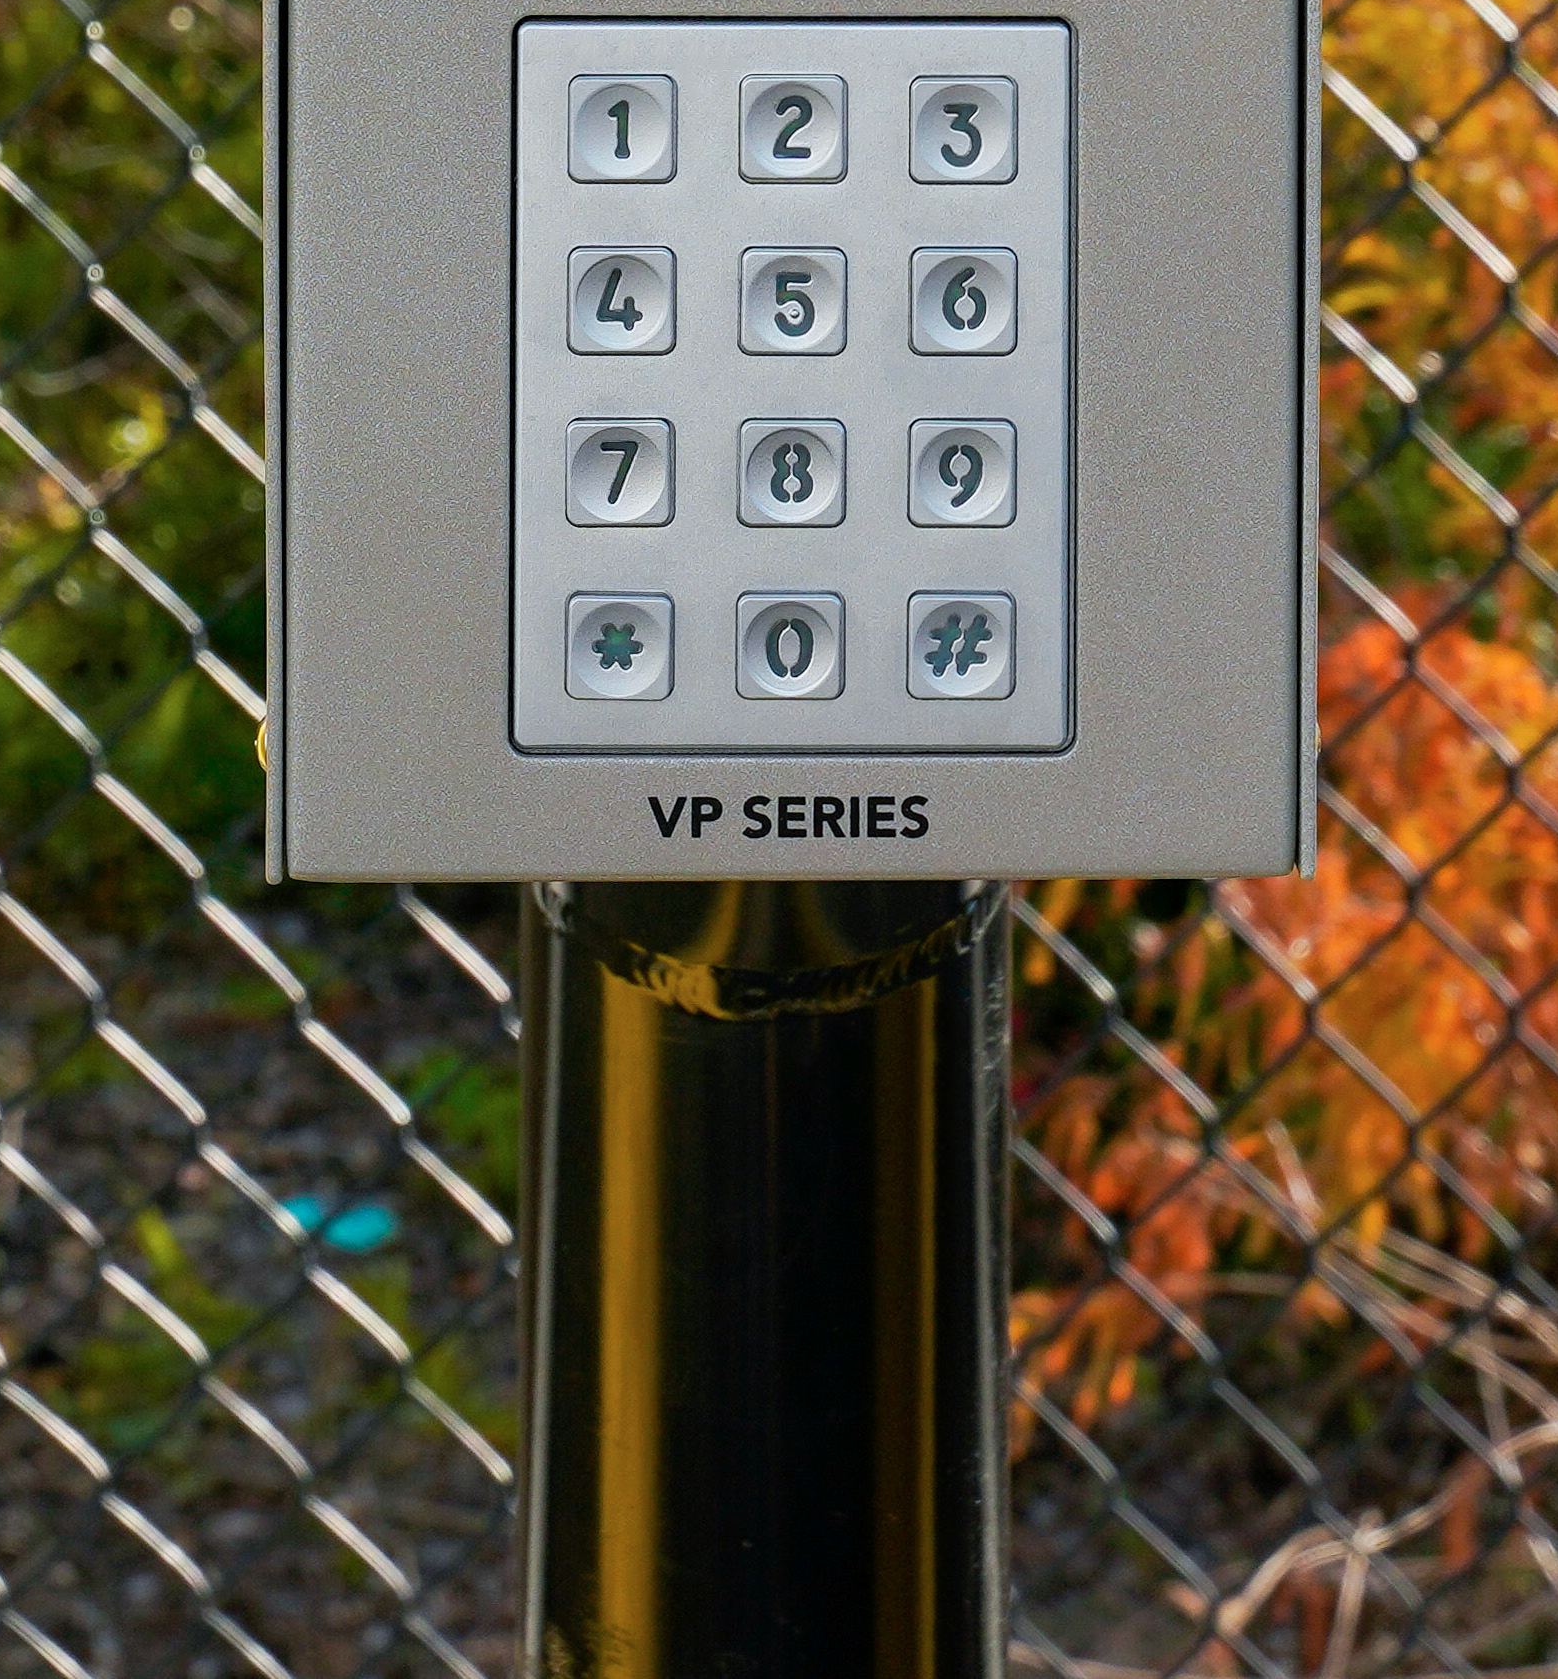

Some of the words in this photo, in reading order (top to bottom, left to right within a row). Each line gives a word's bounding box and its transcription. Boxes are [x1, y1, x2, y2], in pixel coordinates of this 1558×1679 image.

[607, 98, 631, 159] 1
[774, 94, 814, 159] 2
[940, 103, 983, 168] 3
[595, 266, 644, 332] 4
[773, 271, 816, 338] 5
[941, 266, 988, 331] 6
[599, 440, 639, 506] 7
[770, 442, 815, 504] 8
[937, 443, 984, 509] 9
[764, 617, 815, 679] 0
[923, 612, 994, 678] #
[647, 795, 724, 839] VP
[741, 794, 931, 840] SERIES
